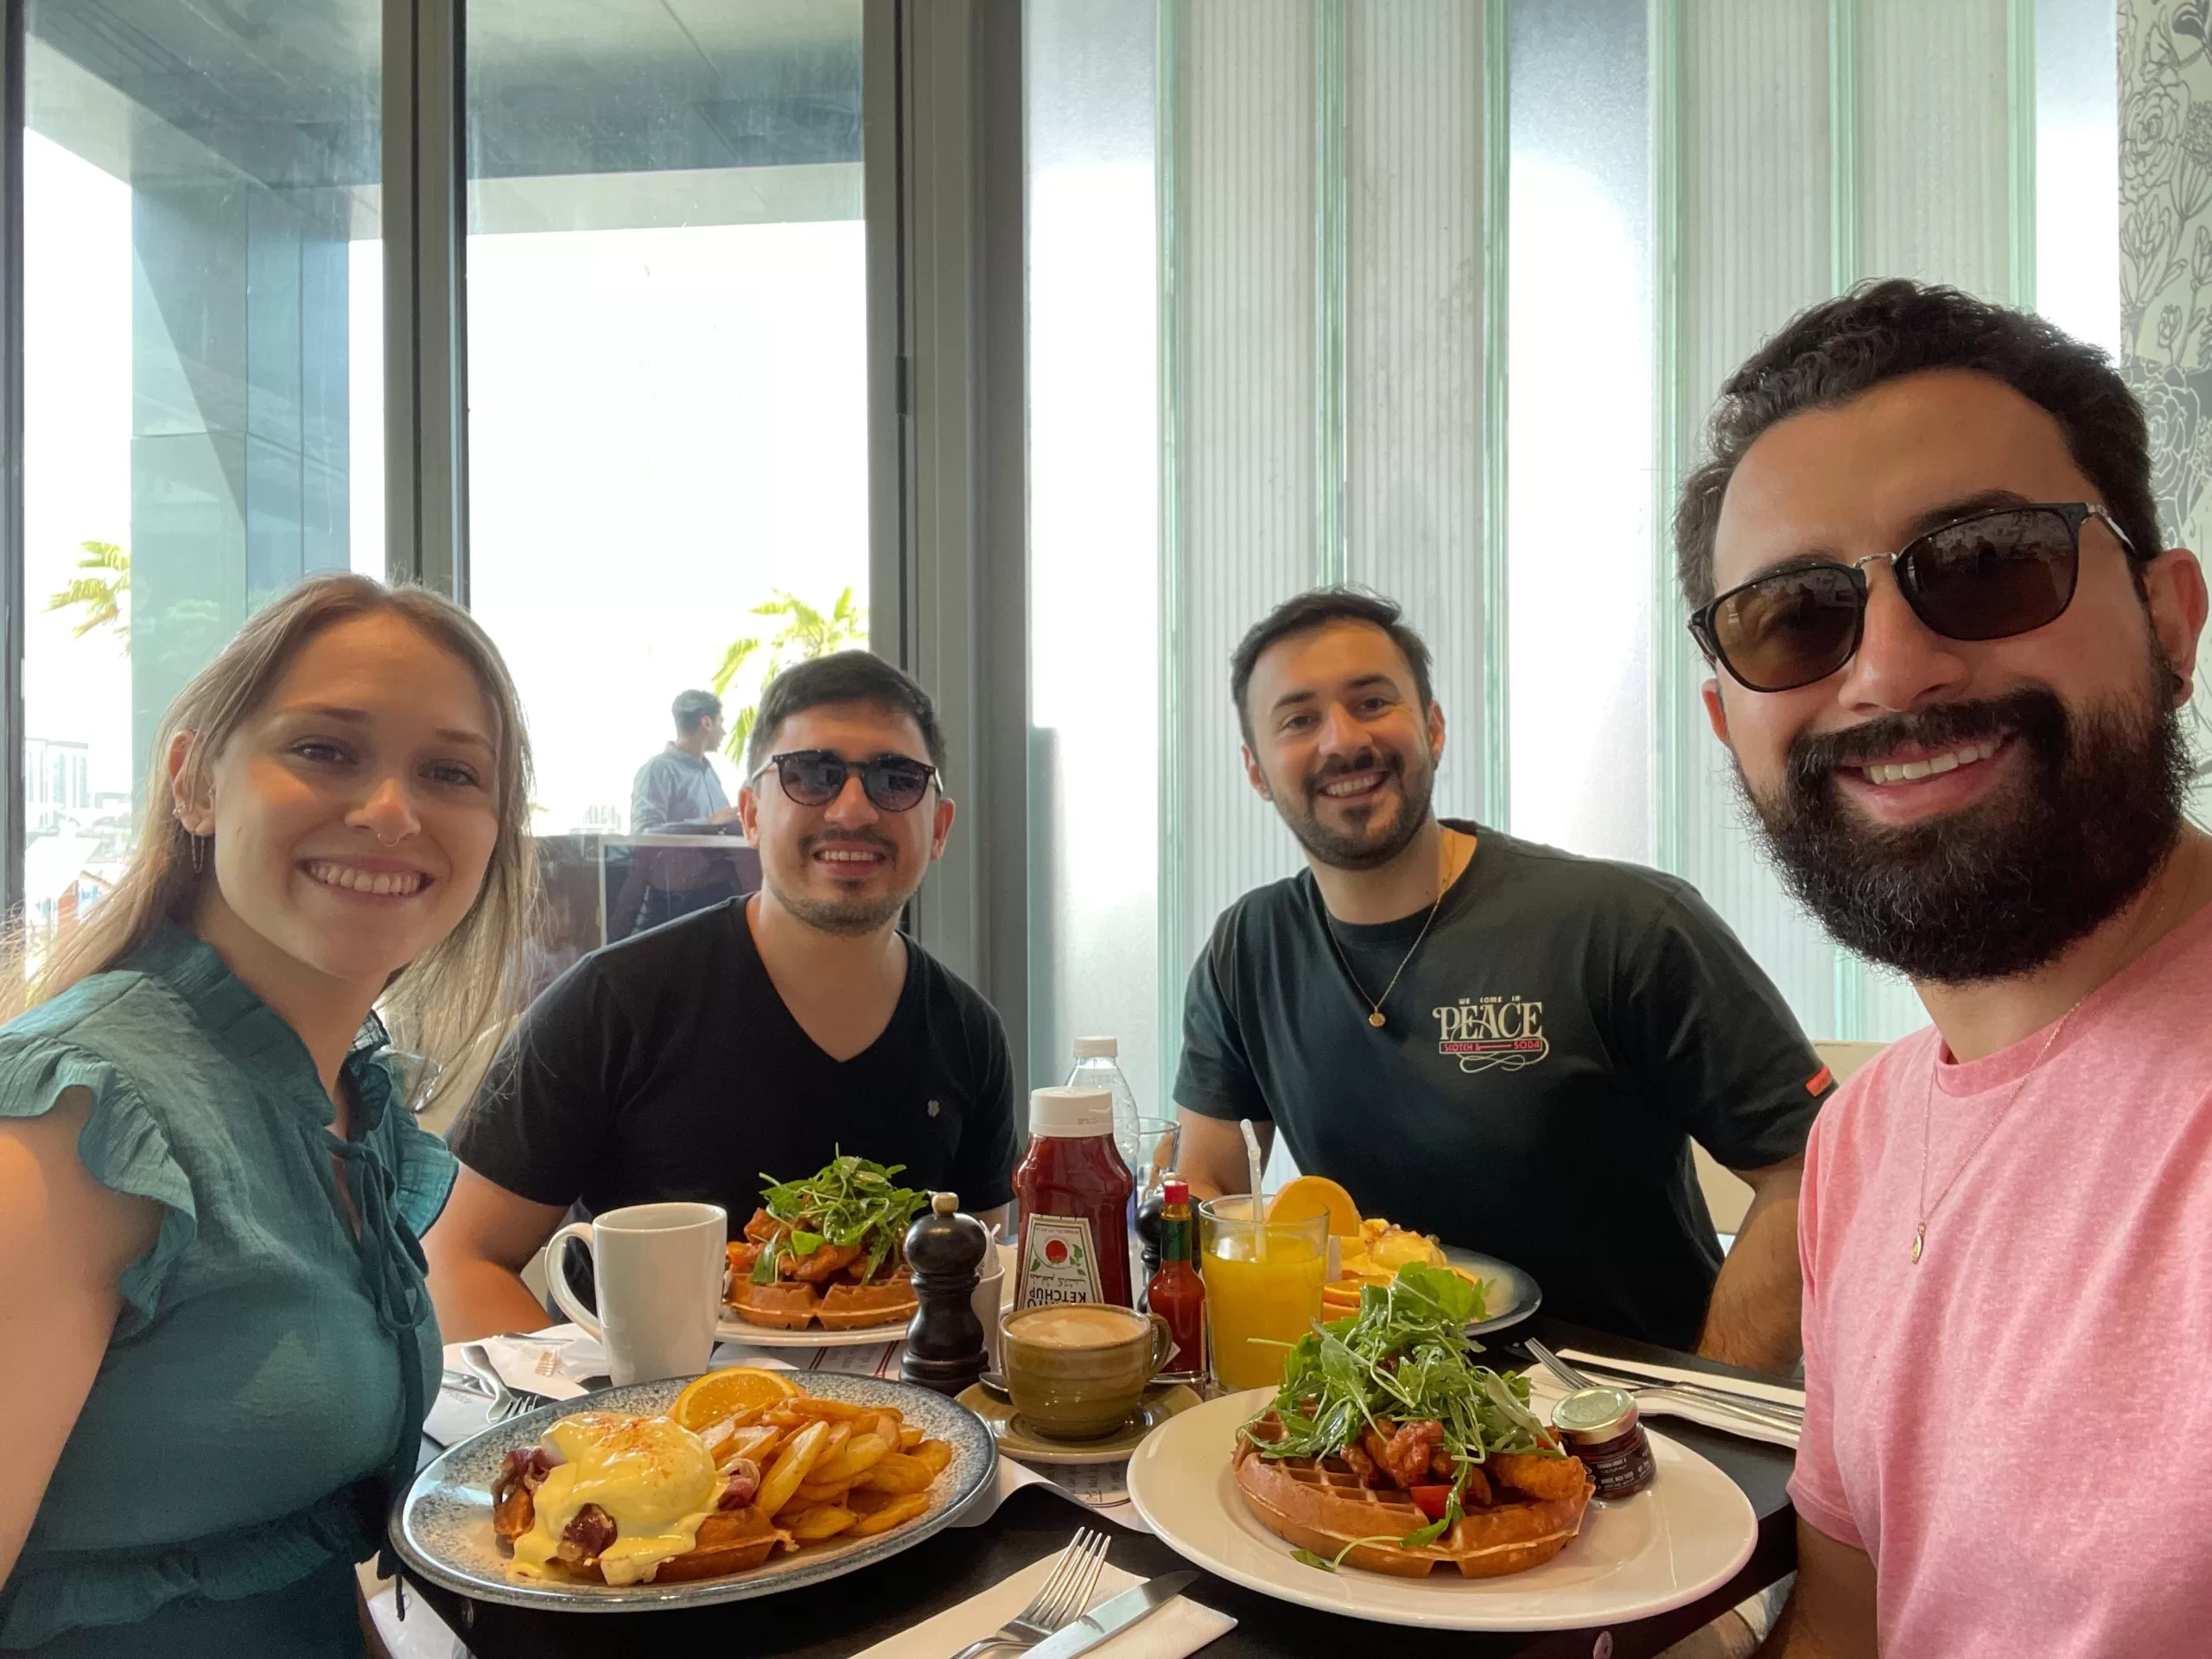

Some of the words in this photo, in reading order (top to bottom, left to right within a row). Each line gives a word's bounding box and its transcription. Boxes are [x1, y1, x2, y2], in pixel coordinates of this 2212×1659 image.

[1433, 1001, 1542, 1039] PEACE
[1514, 1040, 1540, 1049] SODA
[1029, 1287, 1087, 1303] KETCHUP
